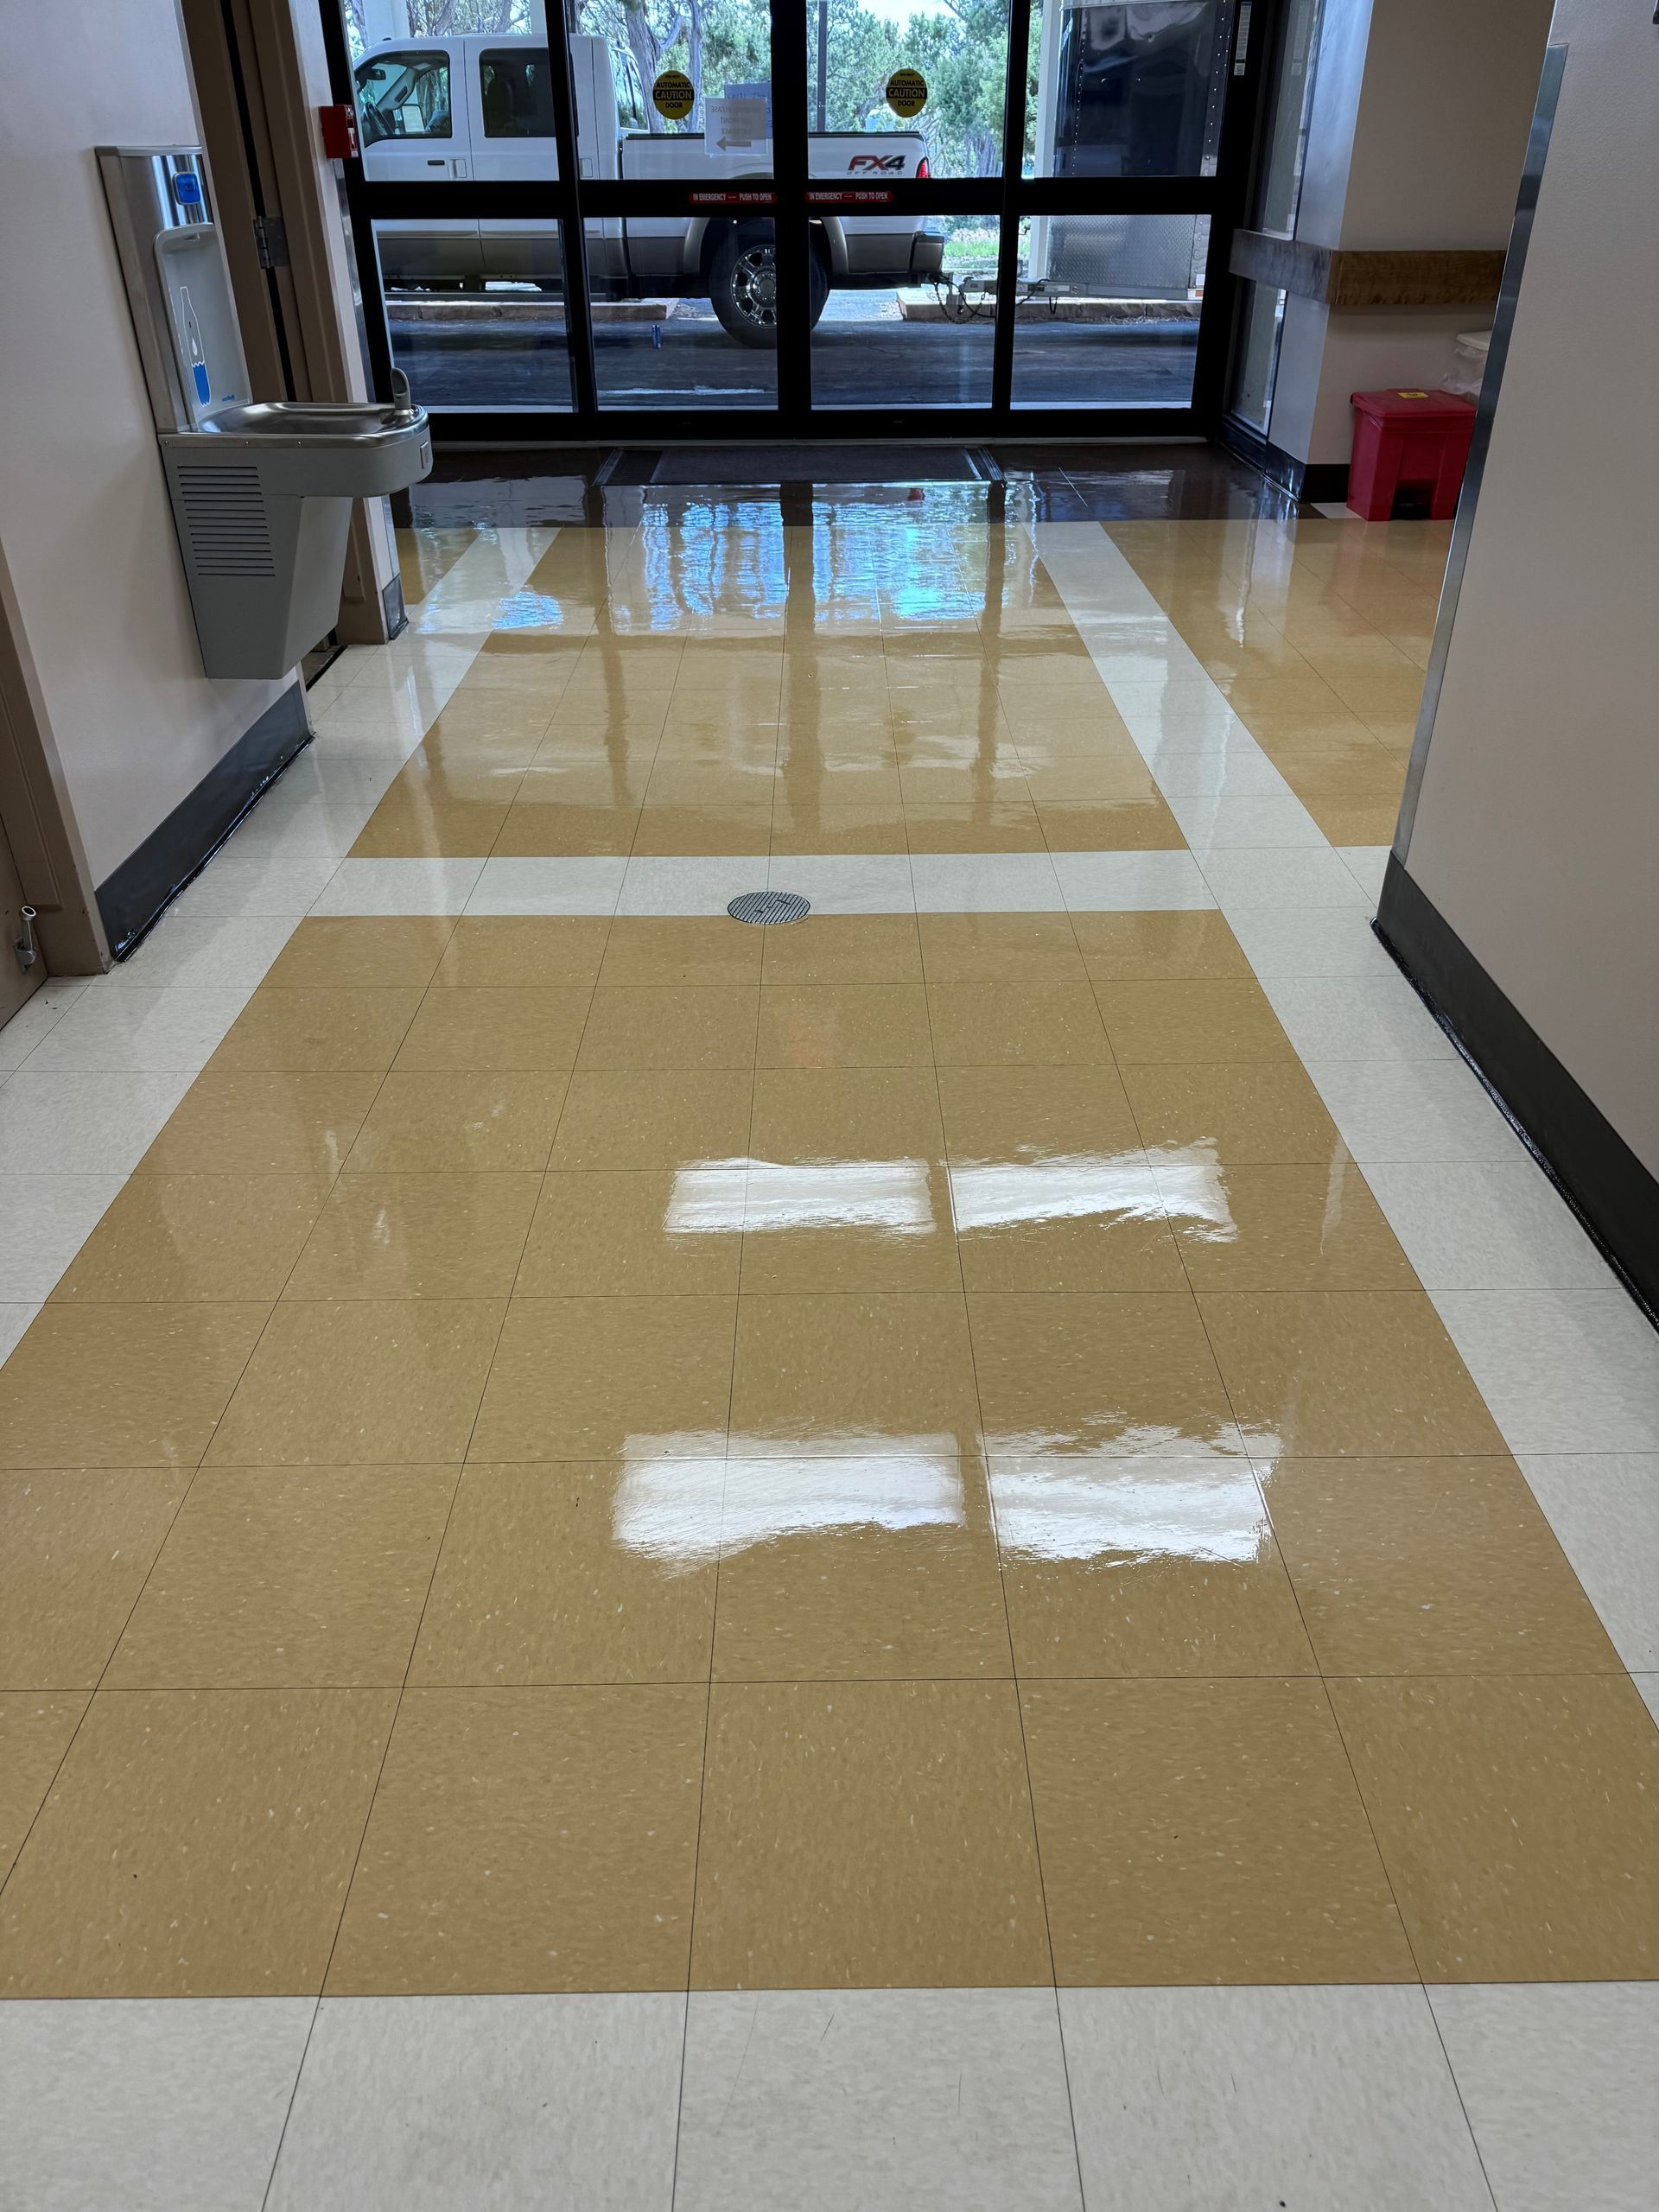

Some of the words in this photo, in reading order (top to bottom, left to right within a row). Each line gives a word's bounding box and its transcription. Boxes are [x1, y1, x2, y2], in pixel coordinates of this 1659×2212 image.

[655, 90, 692, 99] CAUTION
[888, 88, 925, 98] CAUTION
[848, 155, 906, 171] FX4
[692, 193, 699, 201] IN
[699, 193, 727, 201] EMERGENCY
[739, 193, 752, 201] PUSH
[753, 193, 759, 201] TO
[760, 193, 772, 201] OPEN
[809, 192, 815, 200] IN
[815, 192, 842, 200] EMERGENCY
